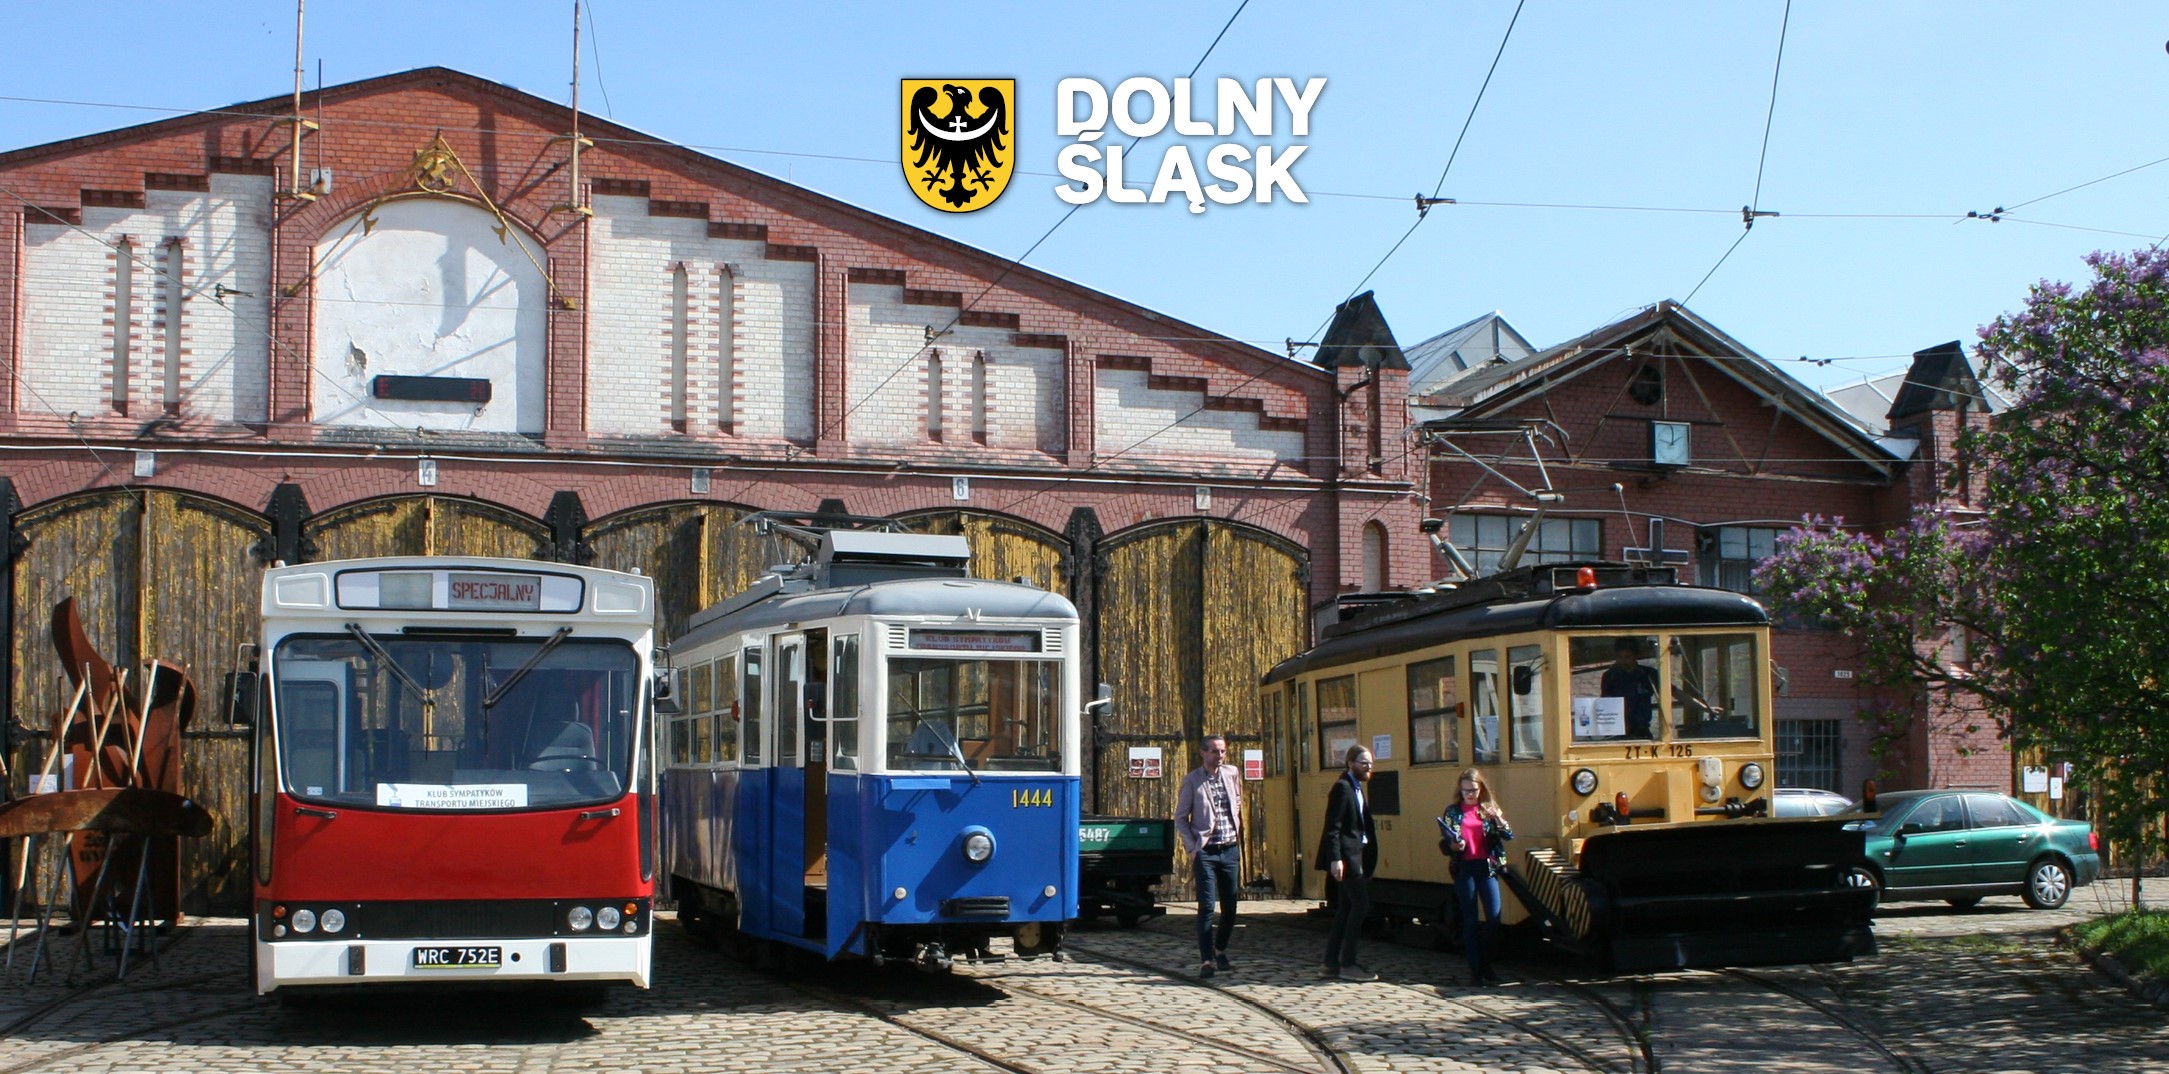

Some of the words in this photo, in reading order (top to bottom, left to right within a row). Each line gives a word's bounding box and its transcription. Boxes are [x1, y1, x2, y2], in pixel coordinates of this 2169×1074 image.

[955, 478, 965, 497] 6
[1198, 489, 1208, 508] 7
[452, 582, 534, 602] SPECJALNY
[1669, 745, 1692, 757] 126
[427, 789, 448, 798] KLUB
[450, 788, 504, 798] SYMPATYKÓW
[1012, 789, 1053, 808] 1444
[415, 799, 468, 808] TRANSPORTU
[469, 799, 516, 808] MIEJSKIEGO
[1079, 828, 1110, 842] 5487
[417, 949, 450, 964] WRC
[457, 948, 499, 964] 752E
